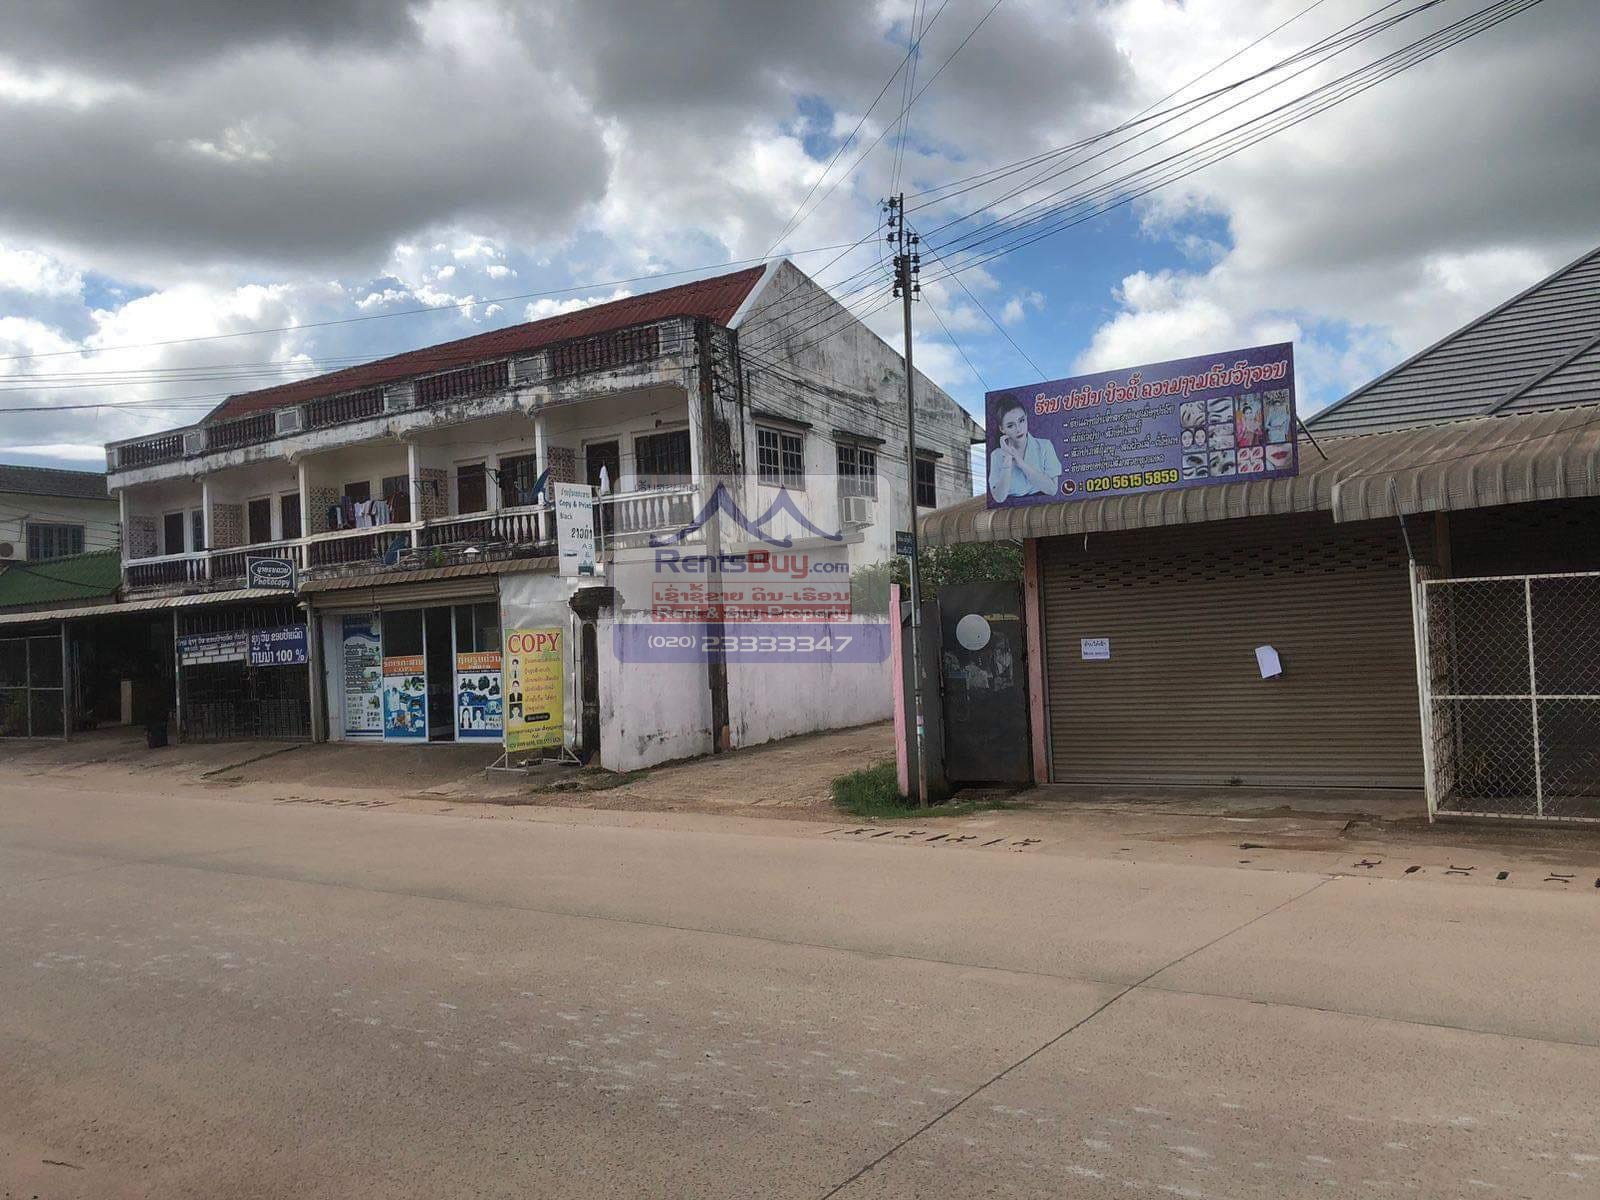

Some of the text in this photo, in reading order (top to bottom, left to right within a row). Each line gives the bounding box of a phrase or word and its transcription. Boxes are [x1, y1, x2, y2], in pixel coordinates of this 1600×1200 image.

[1086, 469, 1179, 492] 020 5615 5859
[509, 633, 560, 653] COPY
[276, 649, 293, 662] 100
[295, 648, 305, 661] %
